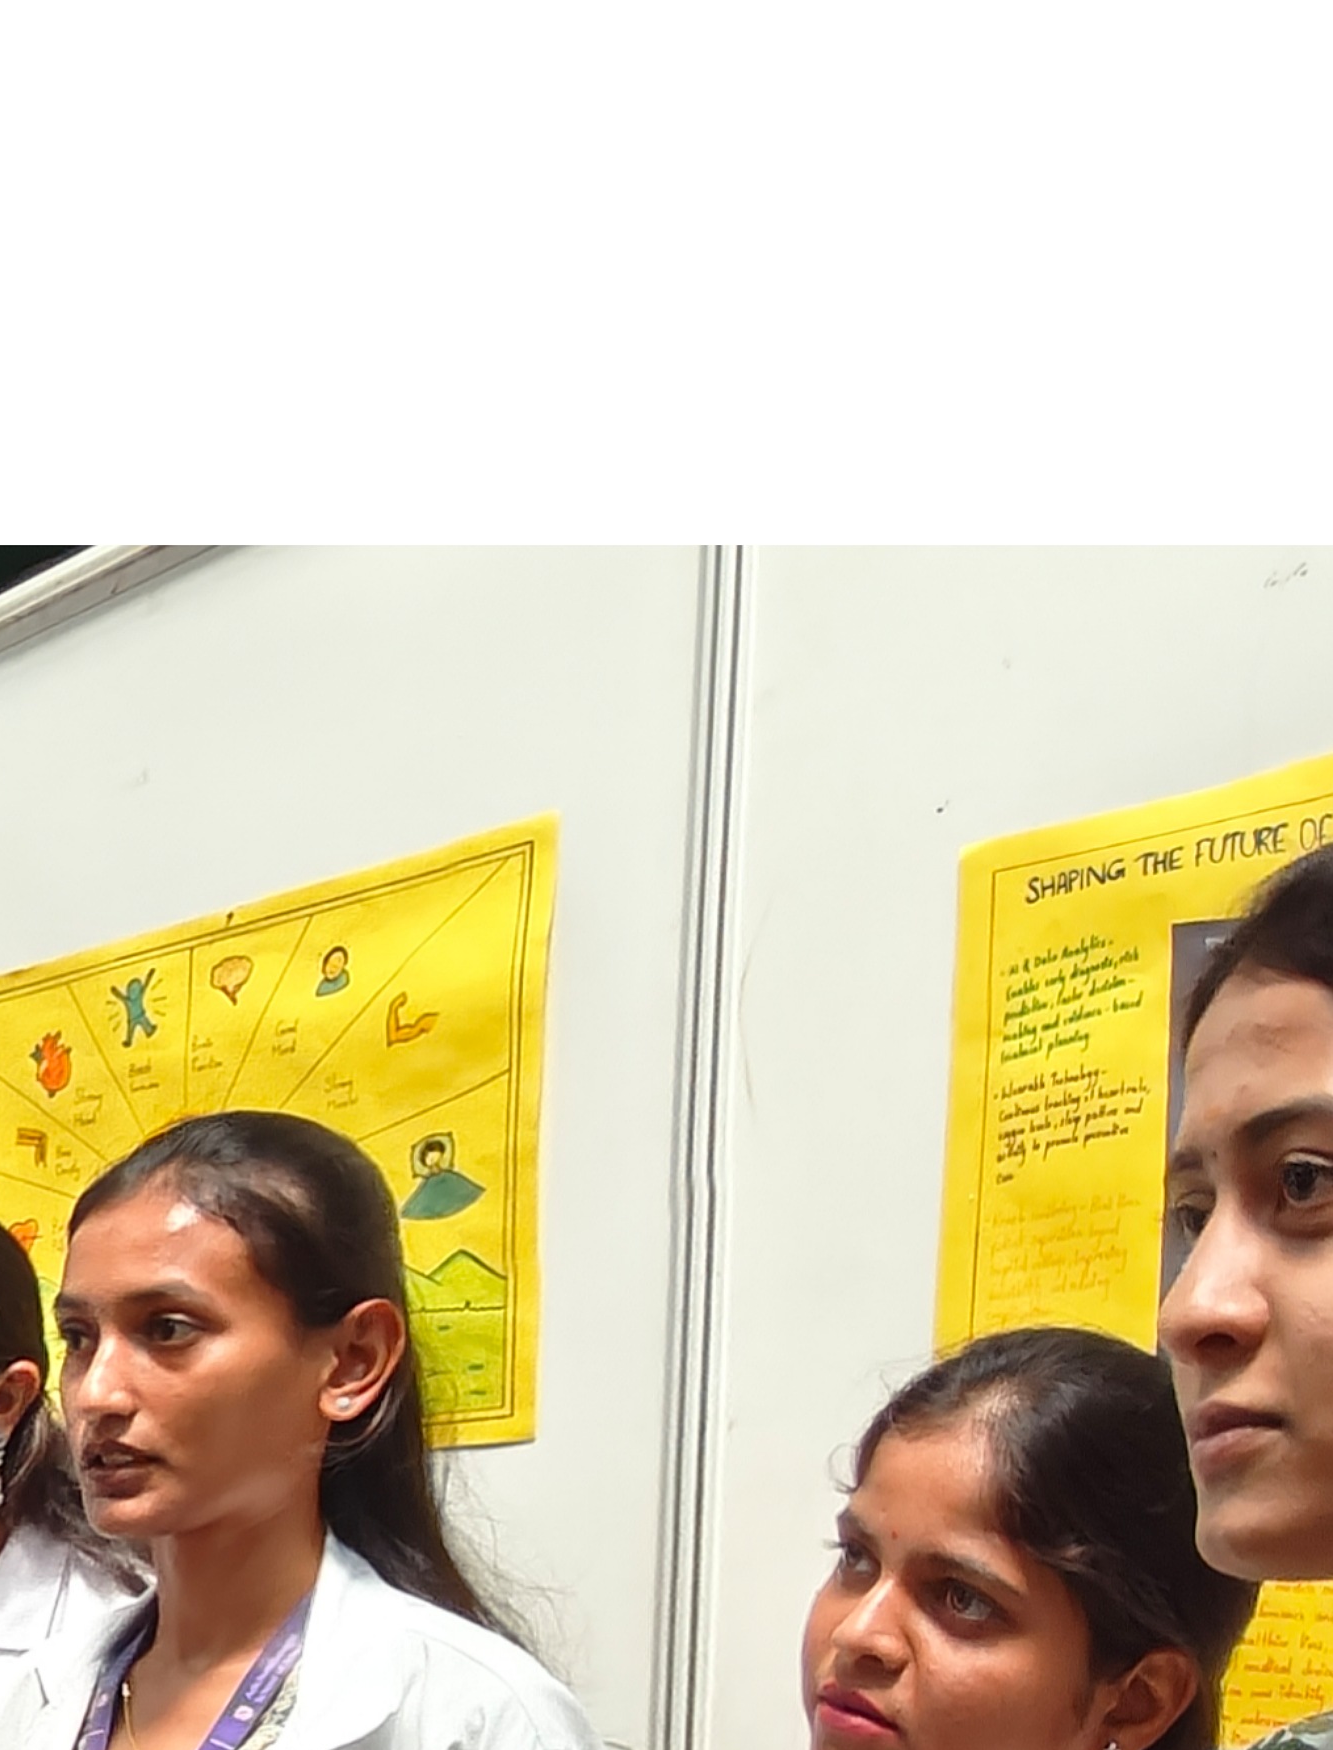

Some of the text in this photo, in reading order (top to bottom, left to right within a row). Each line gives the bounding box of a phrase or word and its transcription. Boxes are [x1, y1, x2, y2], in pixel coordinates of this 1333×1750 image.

[1025, 812, 1333, 905] SHAPING THE FUTURE OF
